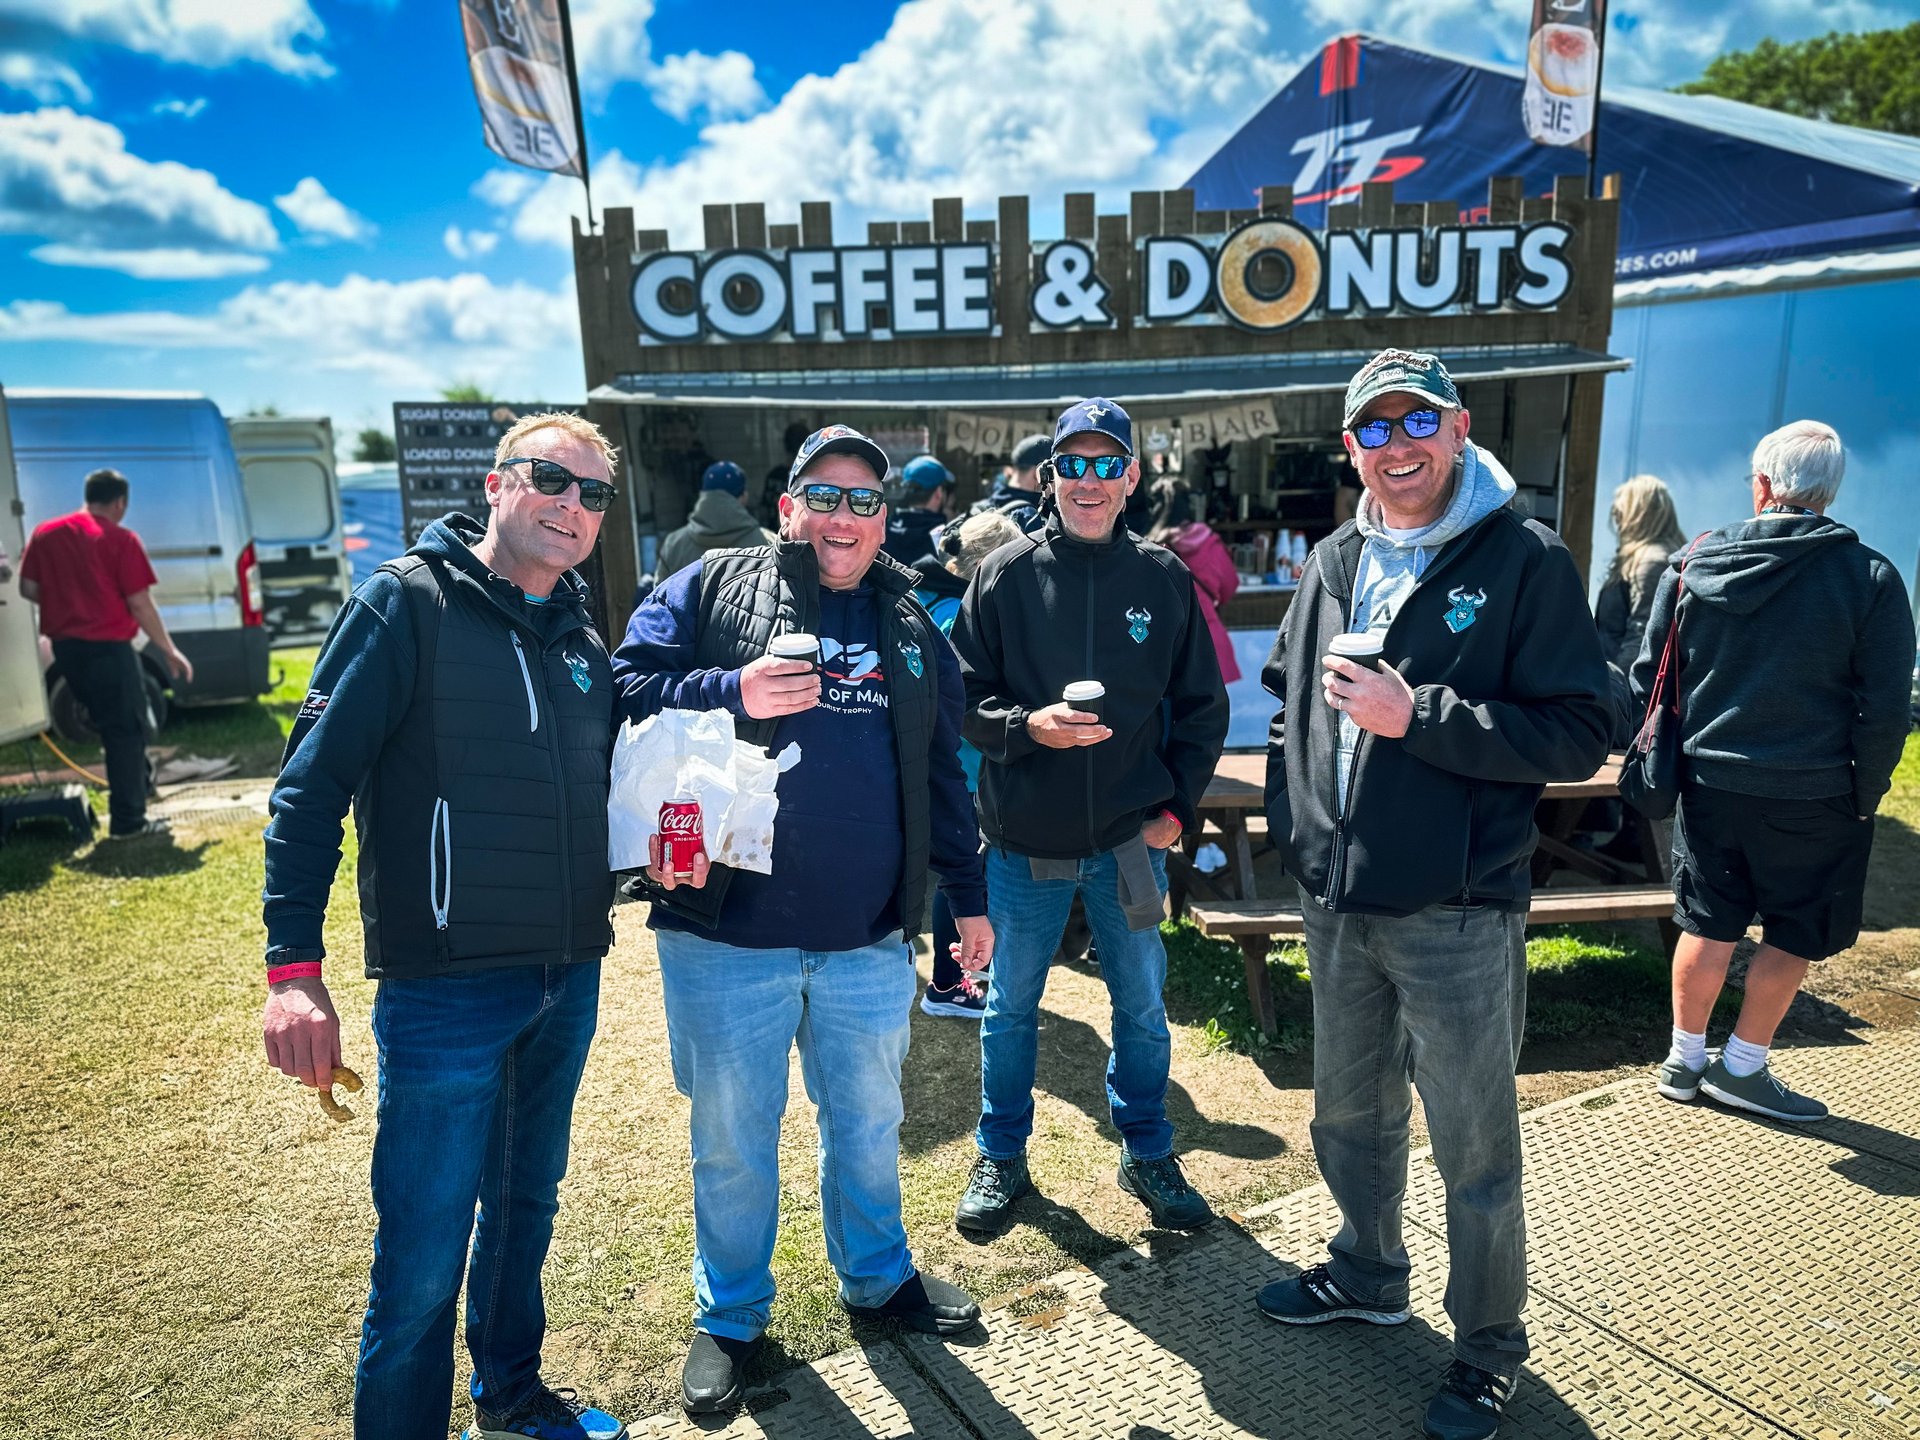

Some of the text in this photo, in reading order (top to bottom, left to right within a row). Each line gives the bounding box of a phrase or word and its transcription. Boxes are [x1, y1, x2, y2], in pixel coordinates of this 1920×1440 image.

[1615, 247, 1698, 274] ES.COM
[631, 220, 1572, 341] COFFEE & DONUTS
[400, 408, 489, 421] SUGAR DONUTS
[1189, 409, 1271, 443] BAR
[403, 447, 496, 461] LOADED DONUT
[816, 701, 842, 713] OURIST
[829, 688, 888, 708] OF MAN
